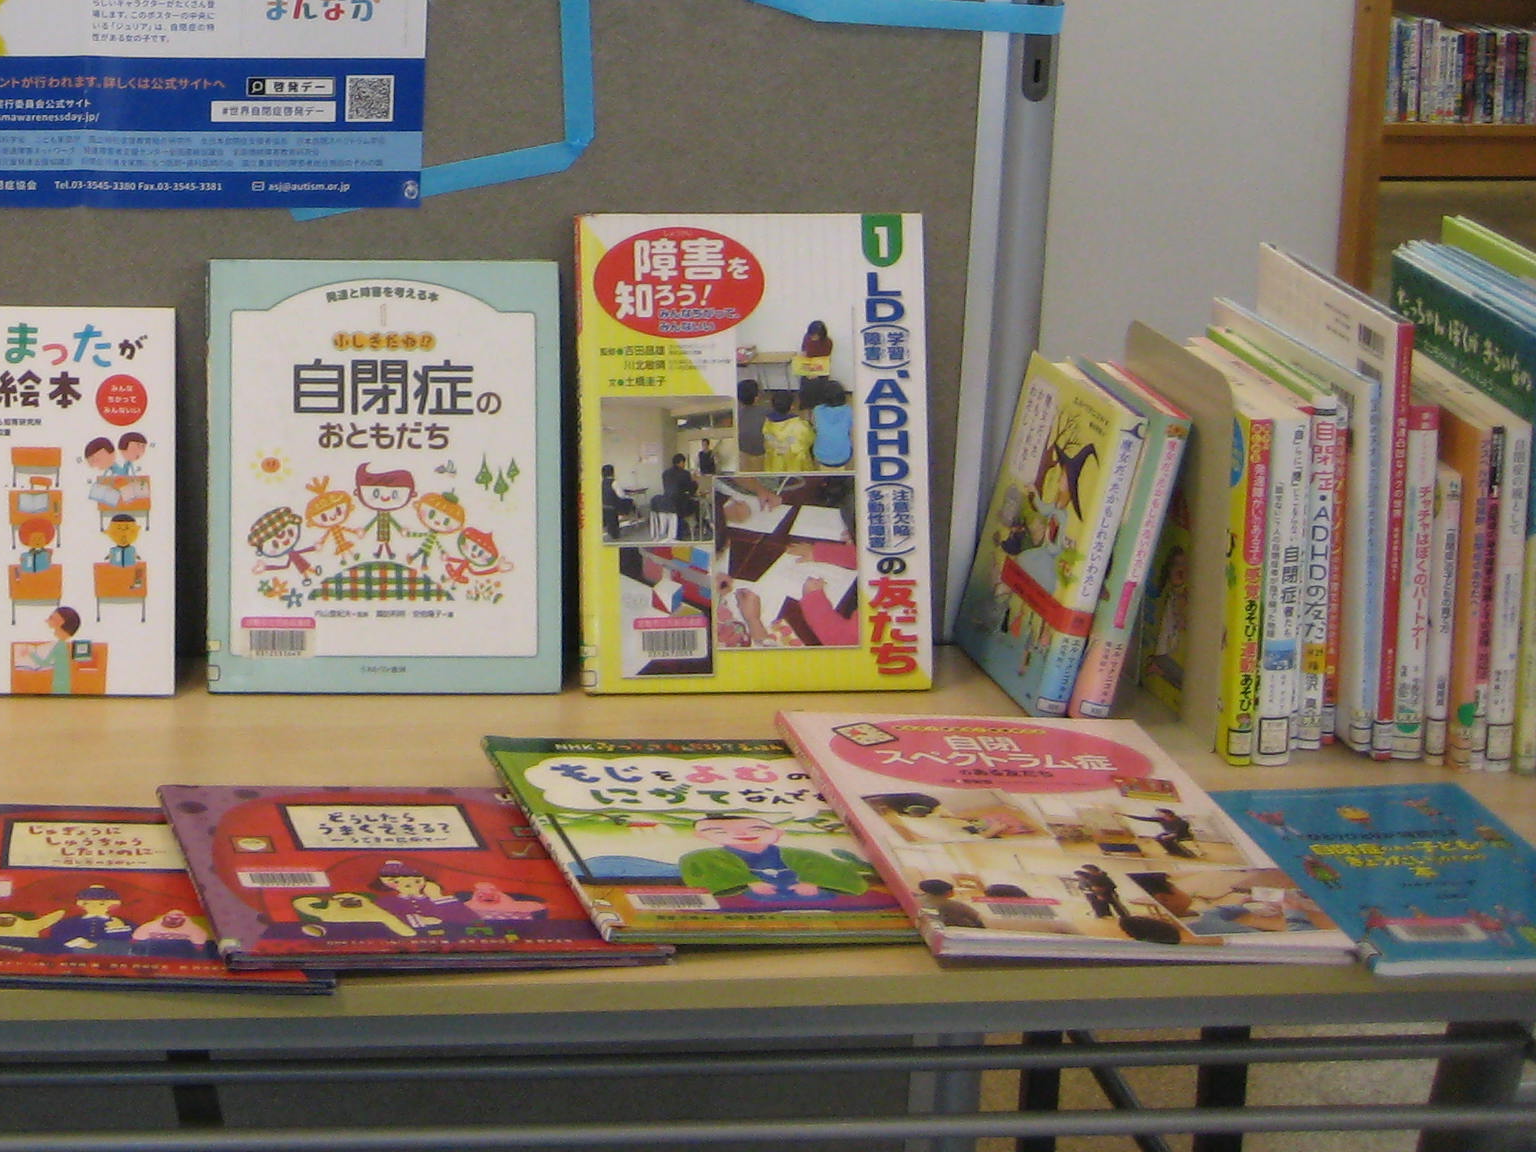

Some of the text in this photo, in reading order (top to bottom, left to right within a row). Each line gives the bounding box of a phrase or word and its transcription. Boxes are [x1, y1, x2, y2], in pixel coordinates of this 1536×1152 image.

[273, 81, 326, 93] 啓発デー
[873, 225, 891, 259] 1
[633, 237, 751, 282] 障害を
[292, 358, 502, 416] 自閉症の
[317, 421, 450, 449] おともだち
[1303, 421, 1336, 643] 自閉症・ADHDの友だ
[944, 735, 1022, 752] 自閉
[874, 749, 1118, 771] スペクトラム症
